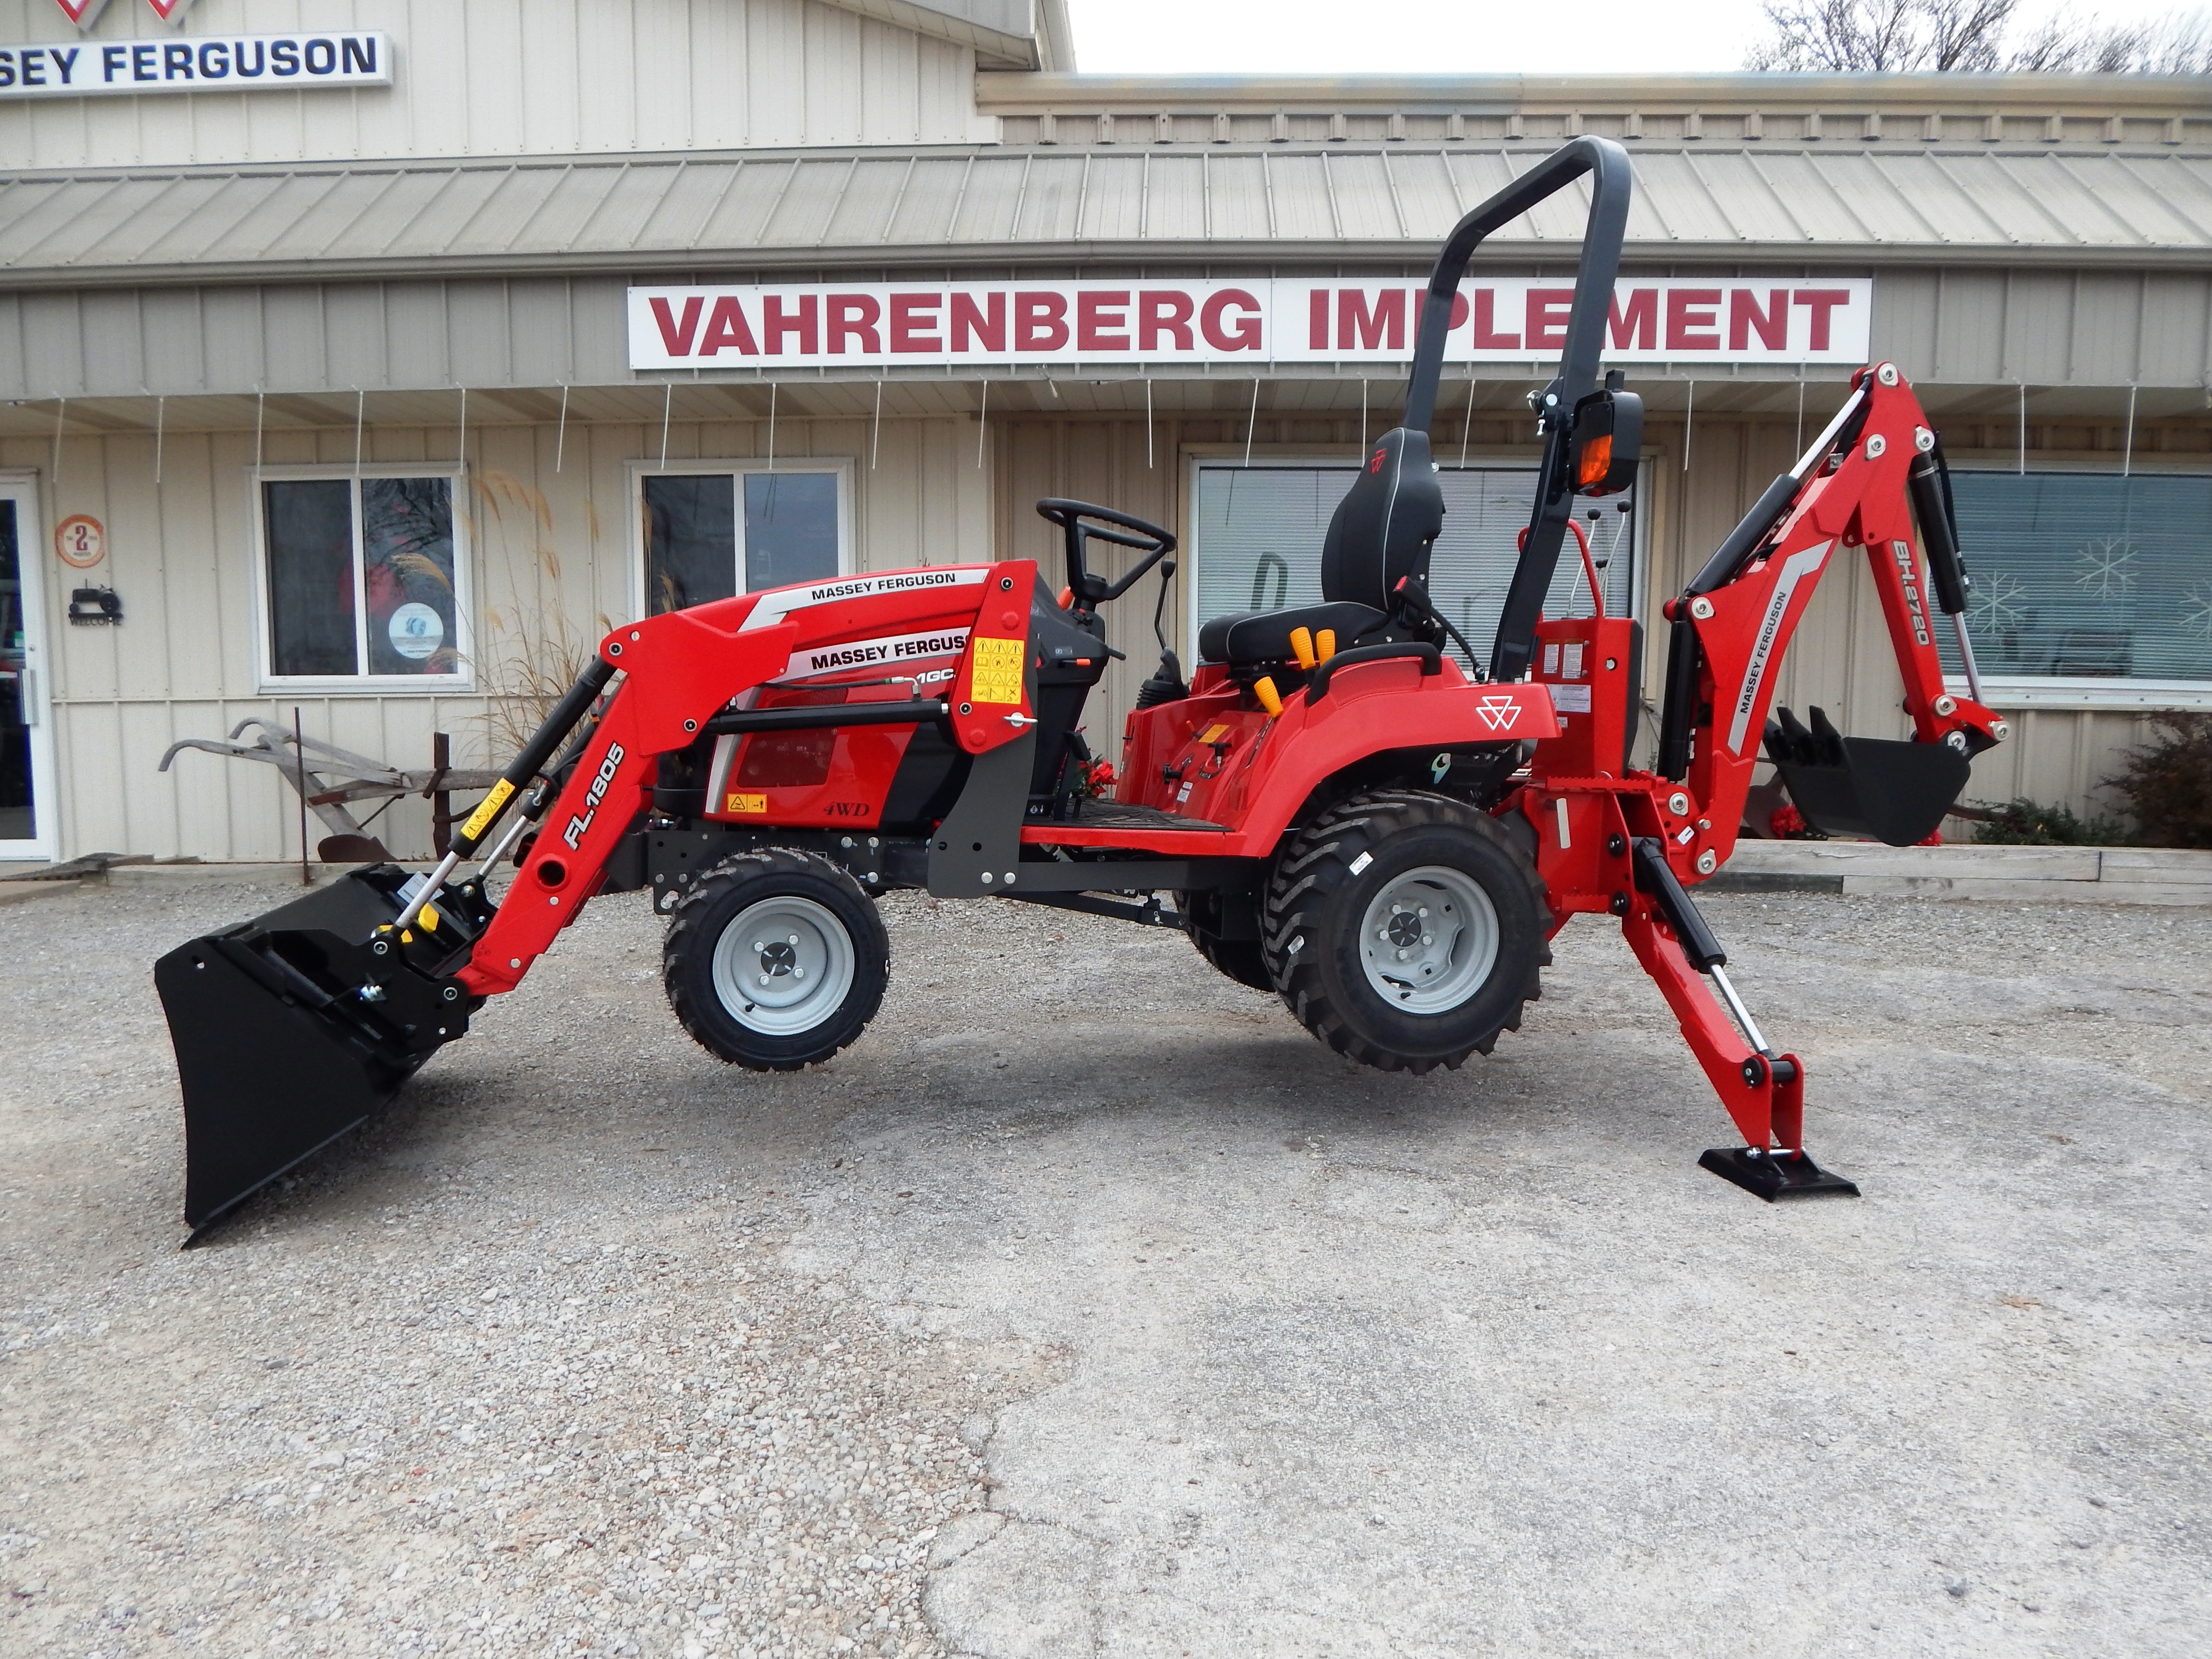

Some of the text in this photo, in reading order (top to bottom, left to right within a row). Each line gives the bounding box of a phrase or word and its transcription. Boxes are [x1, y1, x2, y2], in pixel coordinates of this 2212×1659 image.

[102, 36, 378, 82] FERGUSON
[649, 289, 1262, 356] VAHRENBERG
[75, 525, 87, 551] 2
[812, 573, 955, 600] MASSEY FERGUSON
[1893, 541, 1930, 645] BH.2720
[811, 635, 969, 670] MASSEY FERGUS
[1740, 591, 1786, 714] MASSEY FERGUSON
[564, 742, 624, 851] FL.1805
[823, 801, 870, 816] 4WD
